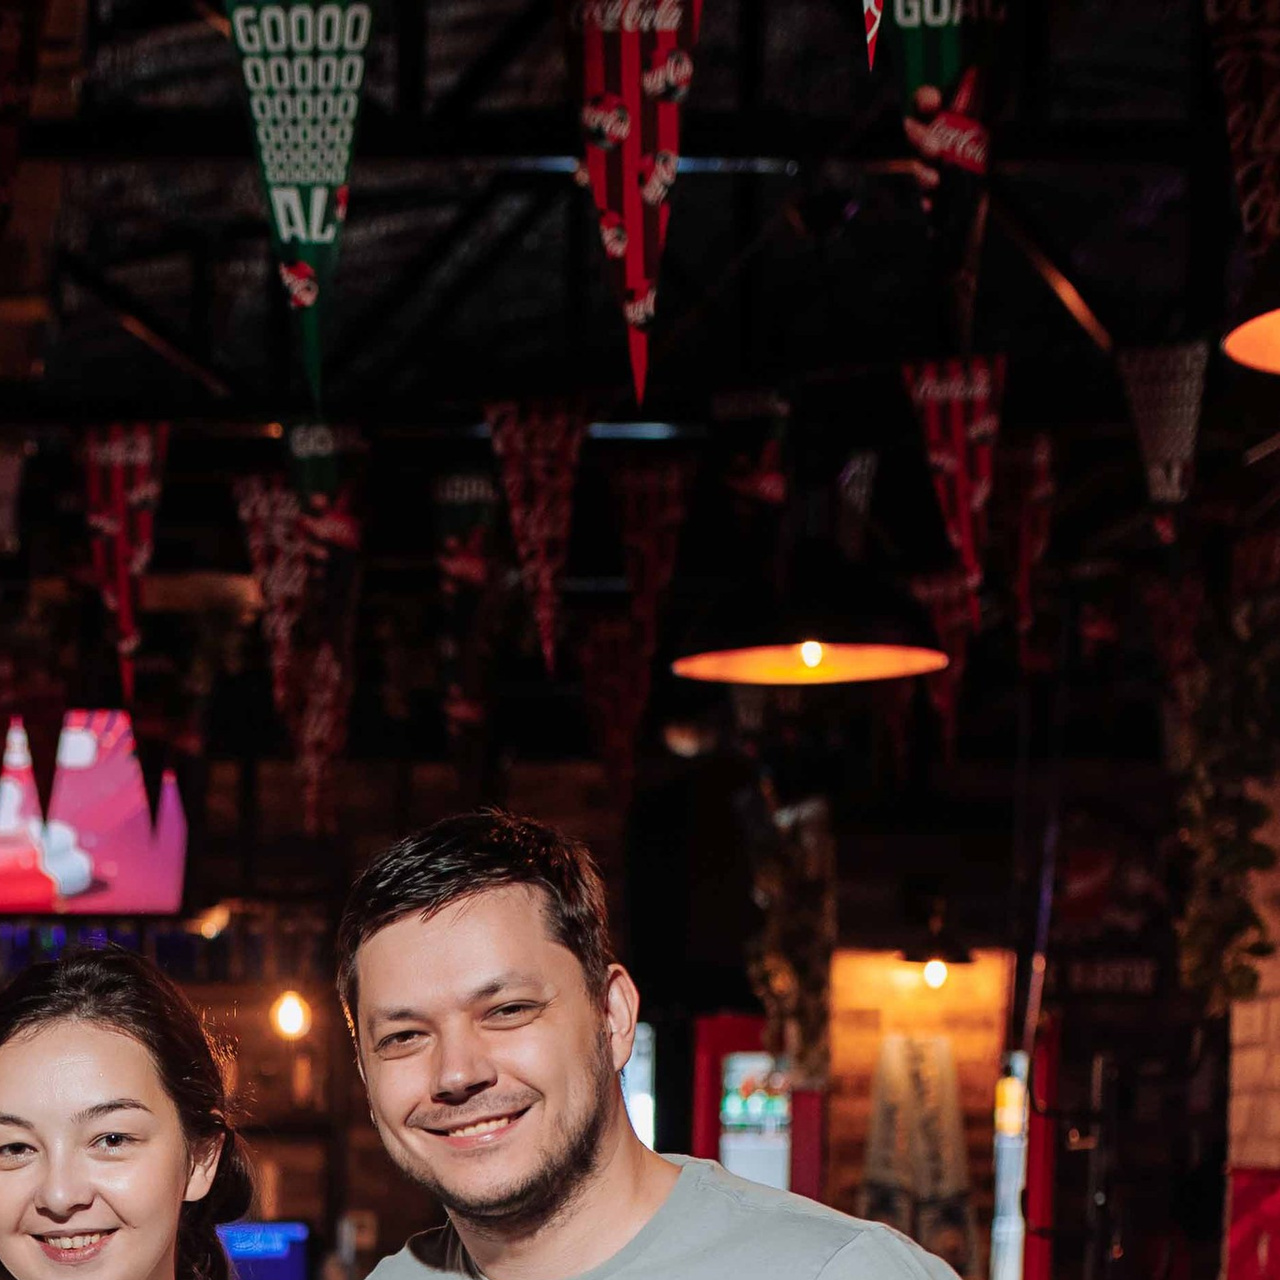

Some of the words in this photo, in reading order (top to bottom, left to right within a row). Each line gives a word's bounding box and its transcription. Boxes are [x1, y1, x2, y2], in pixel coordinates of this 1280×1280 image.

[232, 4, 371, 51] GOOOO
[242, 54, 365, 91] OOOOO
[271, 186, 337, 243] AL
